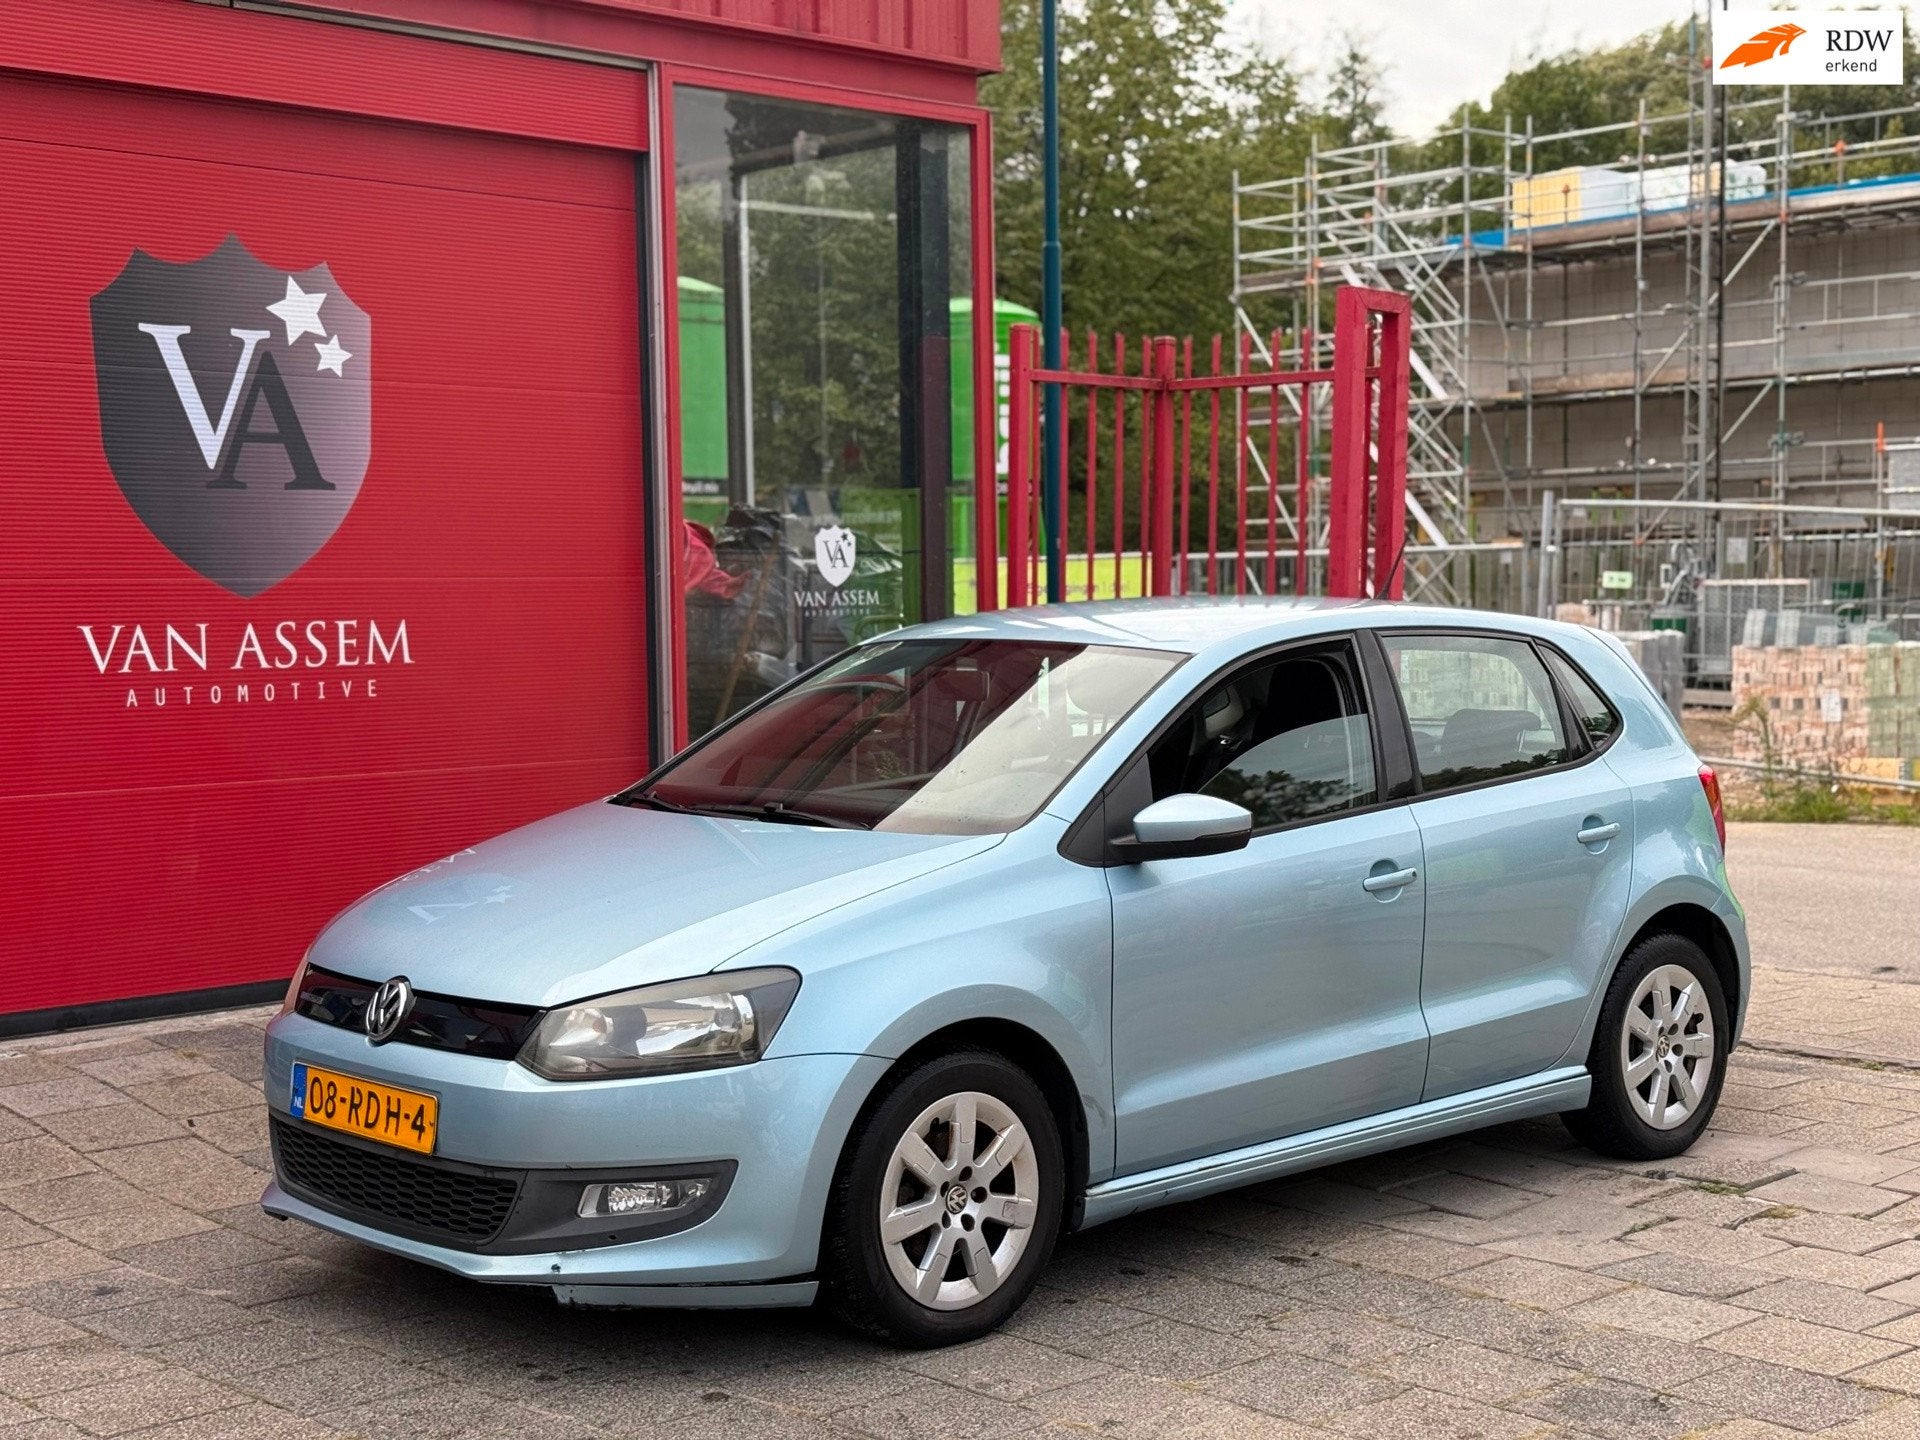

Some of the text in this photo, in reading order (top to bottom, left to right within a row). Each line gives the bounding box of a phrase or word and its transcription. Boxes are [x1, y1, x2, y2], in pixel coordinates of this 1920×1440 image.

[138, 322, 336, 490] VA
[793, 589, 880, 607] VAN ASSEM
[77, 618, 416, 675] VAN ASSEM
[126, 679, 378, 708] AUTOMOTIVE
[293, 1095, 304, 1109] NL
[309, 1076, 427, 1143] 08-RDH-4
